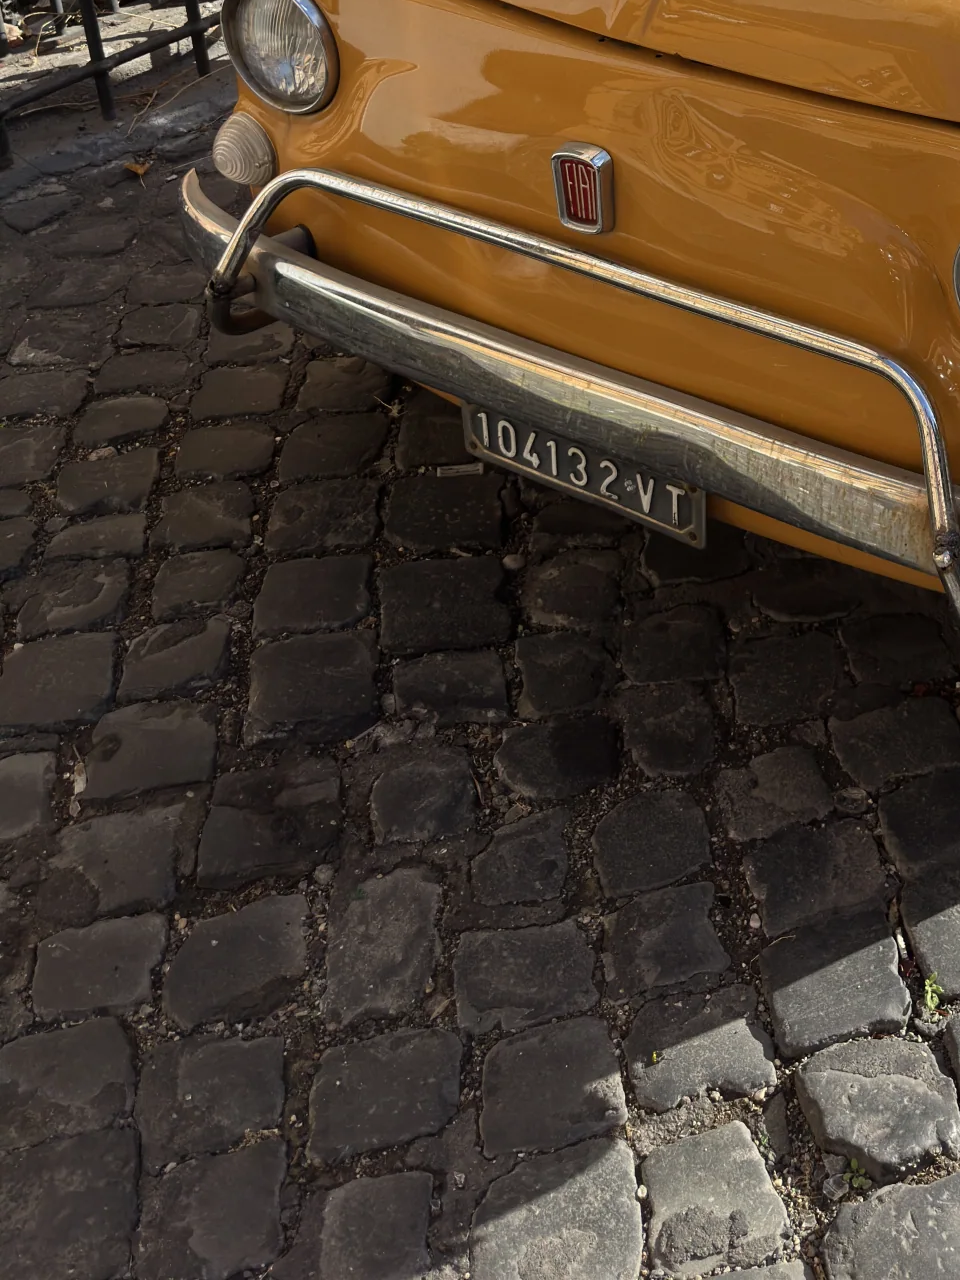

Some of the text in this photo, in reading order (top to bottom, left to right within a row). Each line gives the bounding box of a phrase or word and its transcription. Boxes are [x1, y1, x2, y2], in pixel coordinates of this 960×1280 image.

[565, 163, 597, 220] FIAT
[477, 412, 687, 526] 104132 VT
